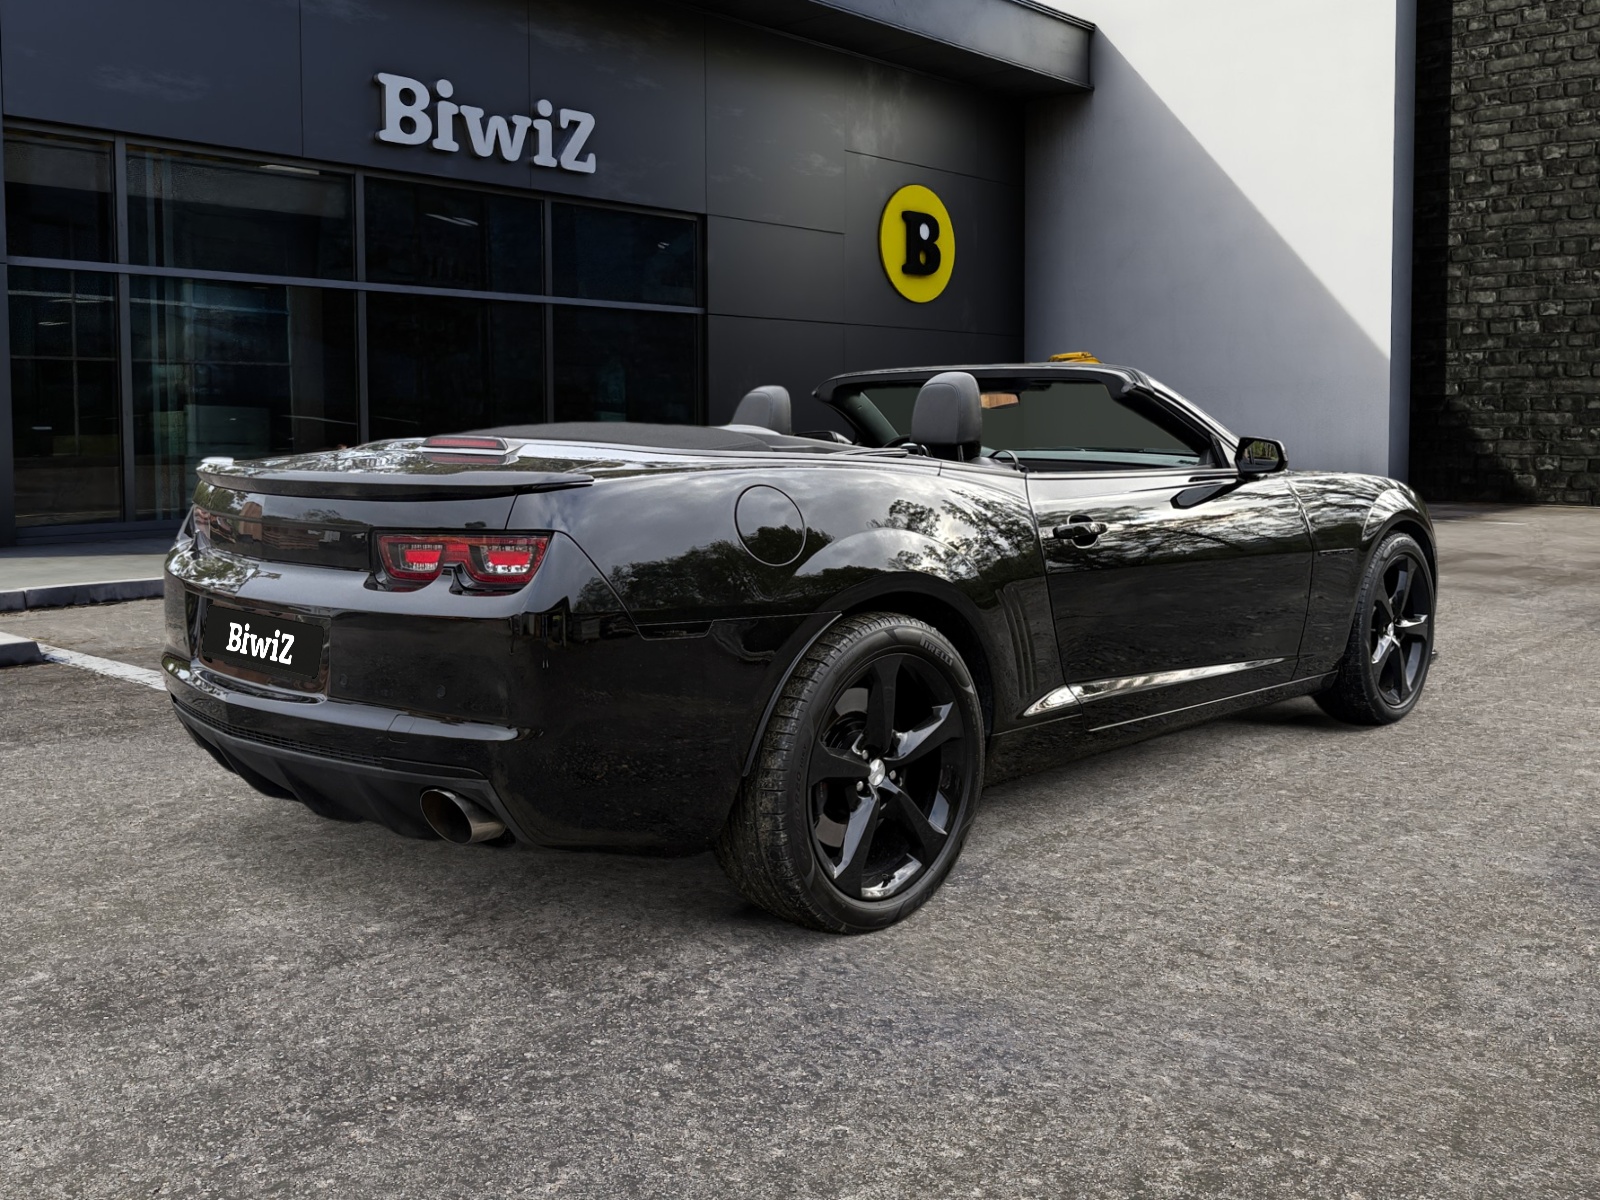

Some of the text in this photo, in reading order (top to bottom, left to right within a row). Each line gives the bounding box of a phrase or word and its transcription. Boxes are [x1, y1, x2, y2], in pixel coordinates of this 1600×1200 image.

[374, 72, 597, 174] BiwiZ
[901, 210, 941, 276] B
[225, 621, 295, 666] BiwiZ
[919, 633, 953, 666] PIRELLI
